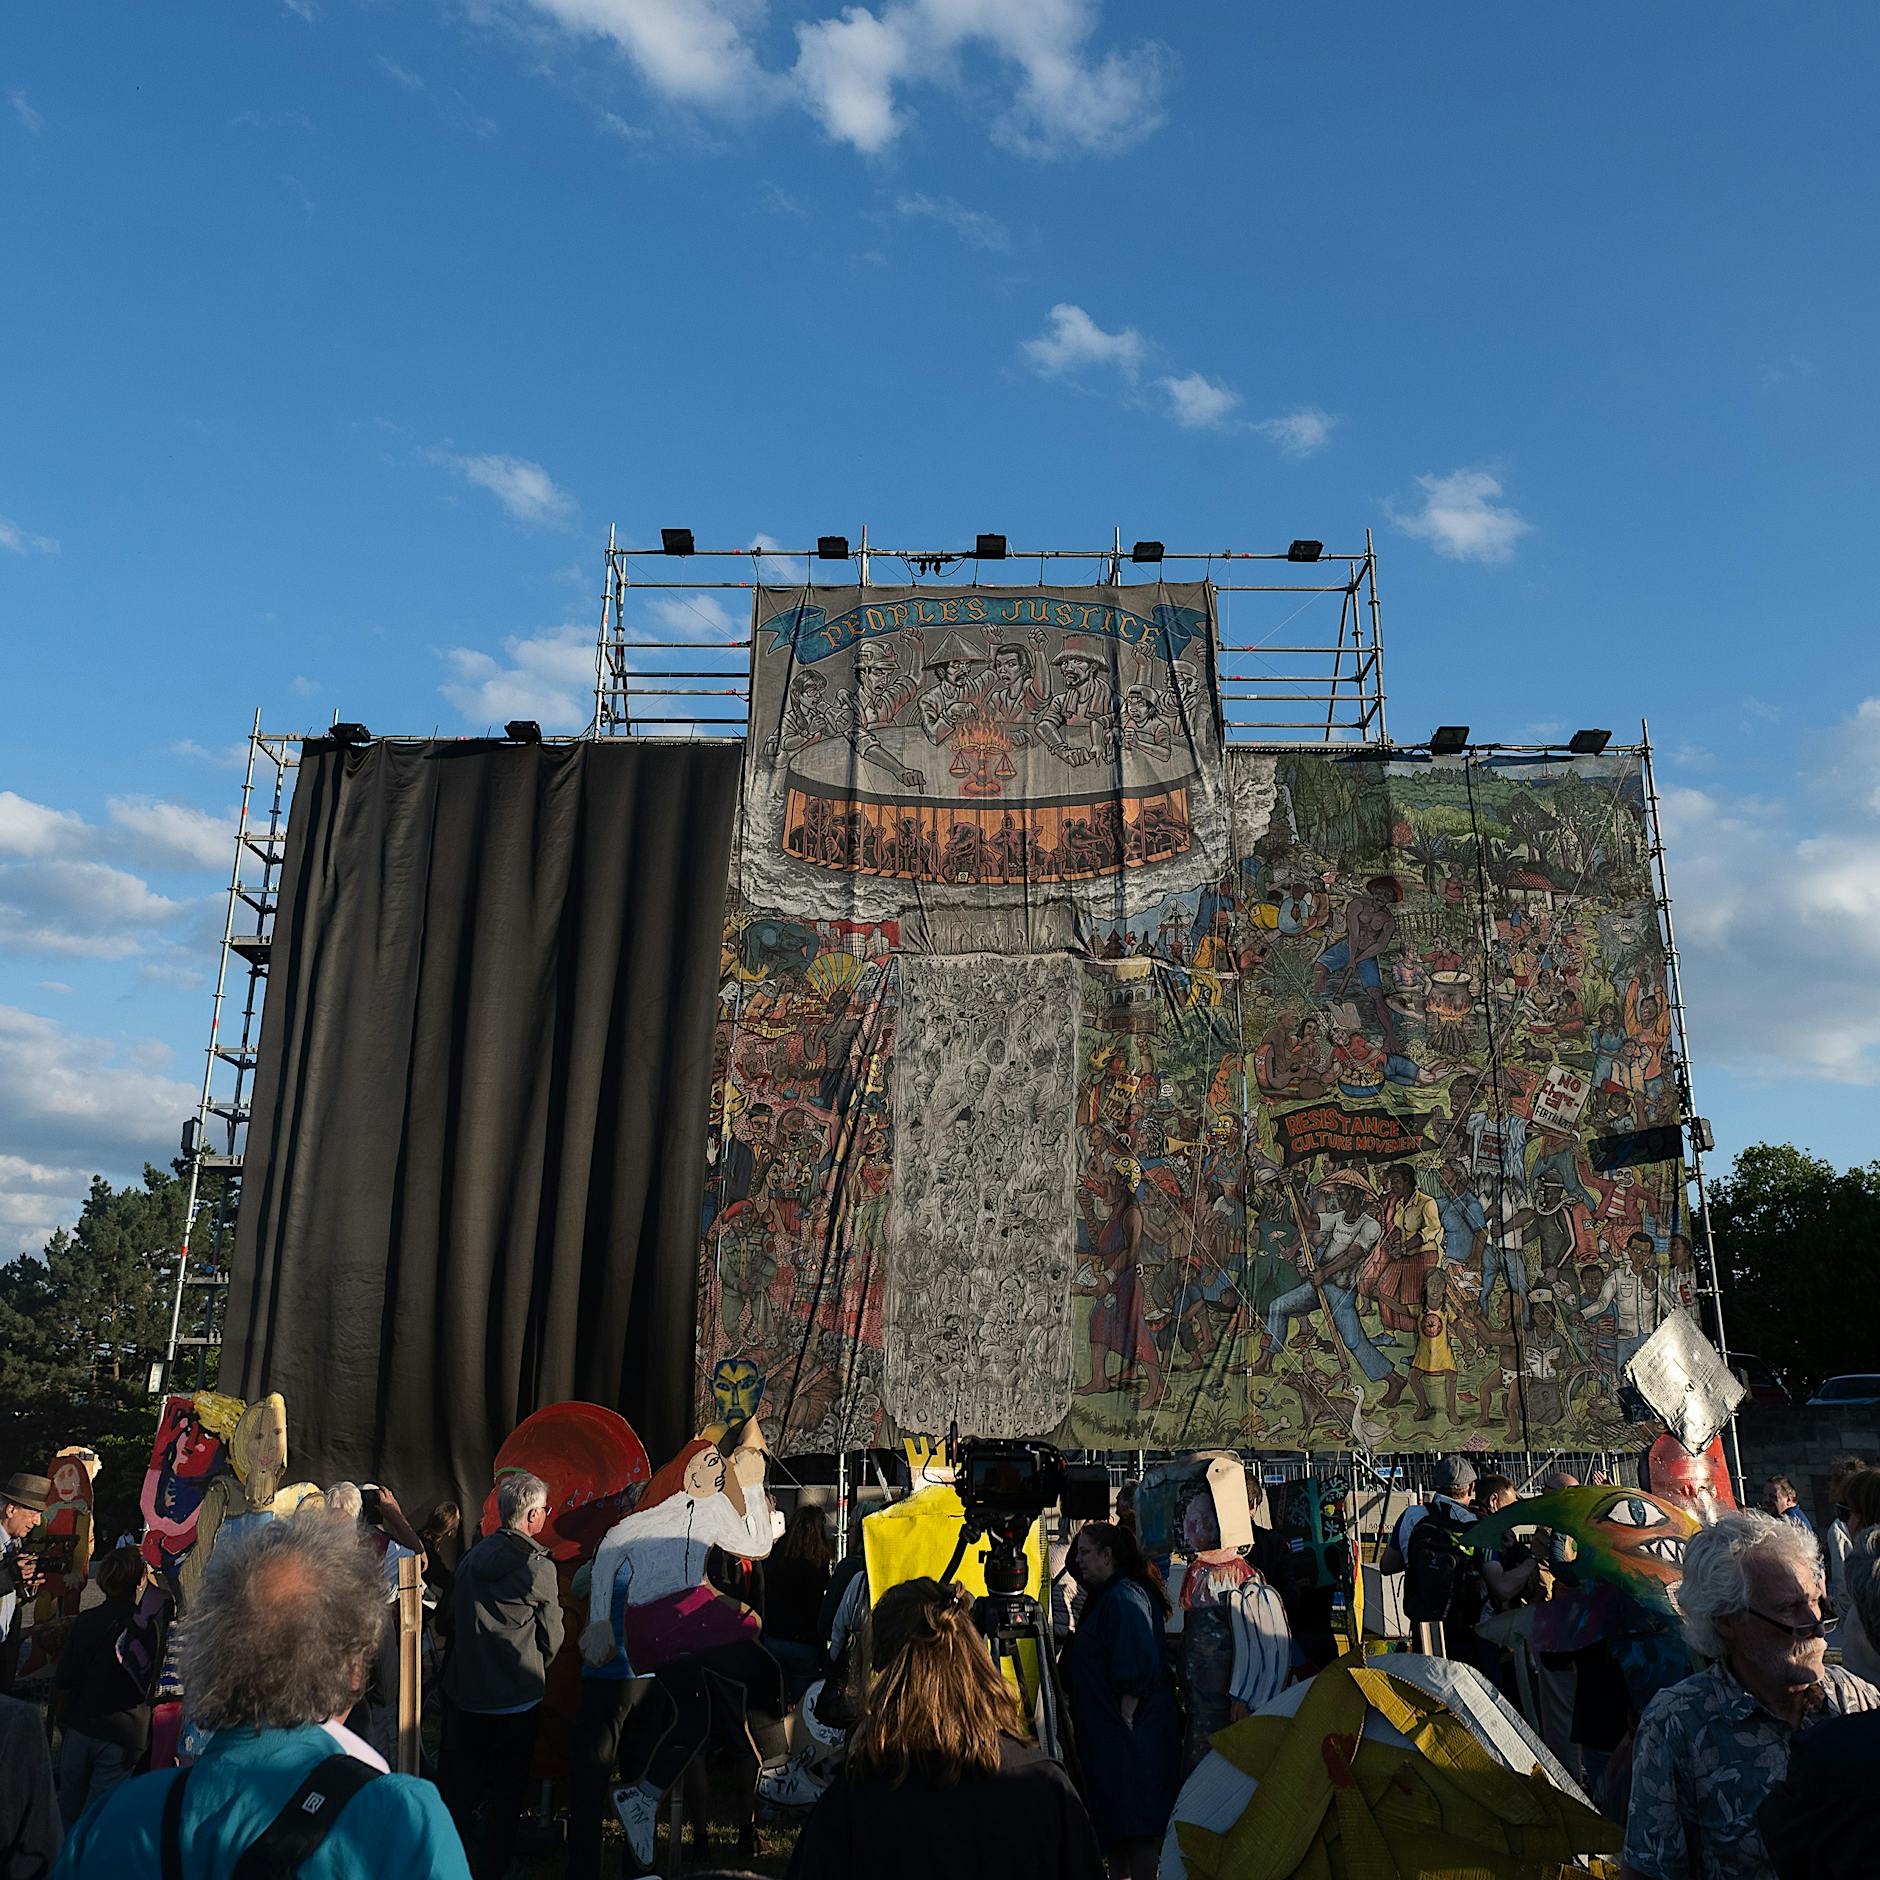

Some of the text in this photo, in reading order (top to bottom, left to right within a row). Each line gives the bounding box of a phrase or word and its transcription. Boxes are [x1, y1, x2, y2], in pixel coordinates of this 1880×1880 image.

[820, 597, 1161, 648] PEOPLE'S JUSTICE
[1557, 1073, 1582, 1093] NO
[1285, 1108, 1400, 1138] RESISTANCE
[1291, 1131, 1424, 1154] CULTURE MOVEMENT
